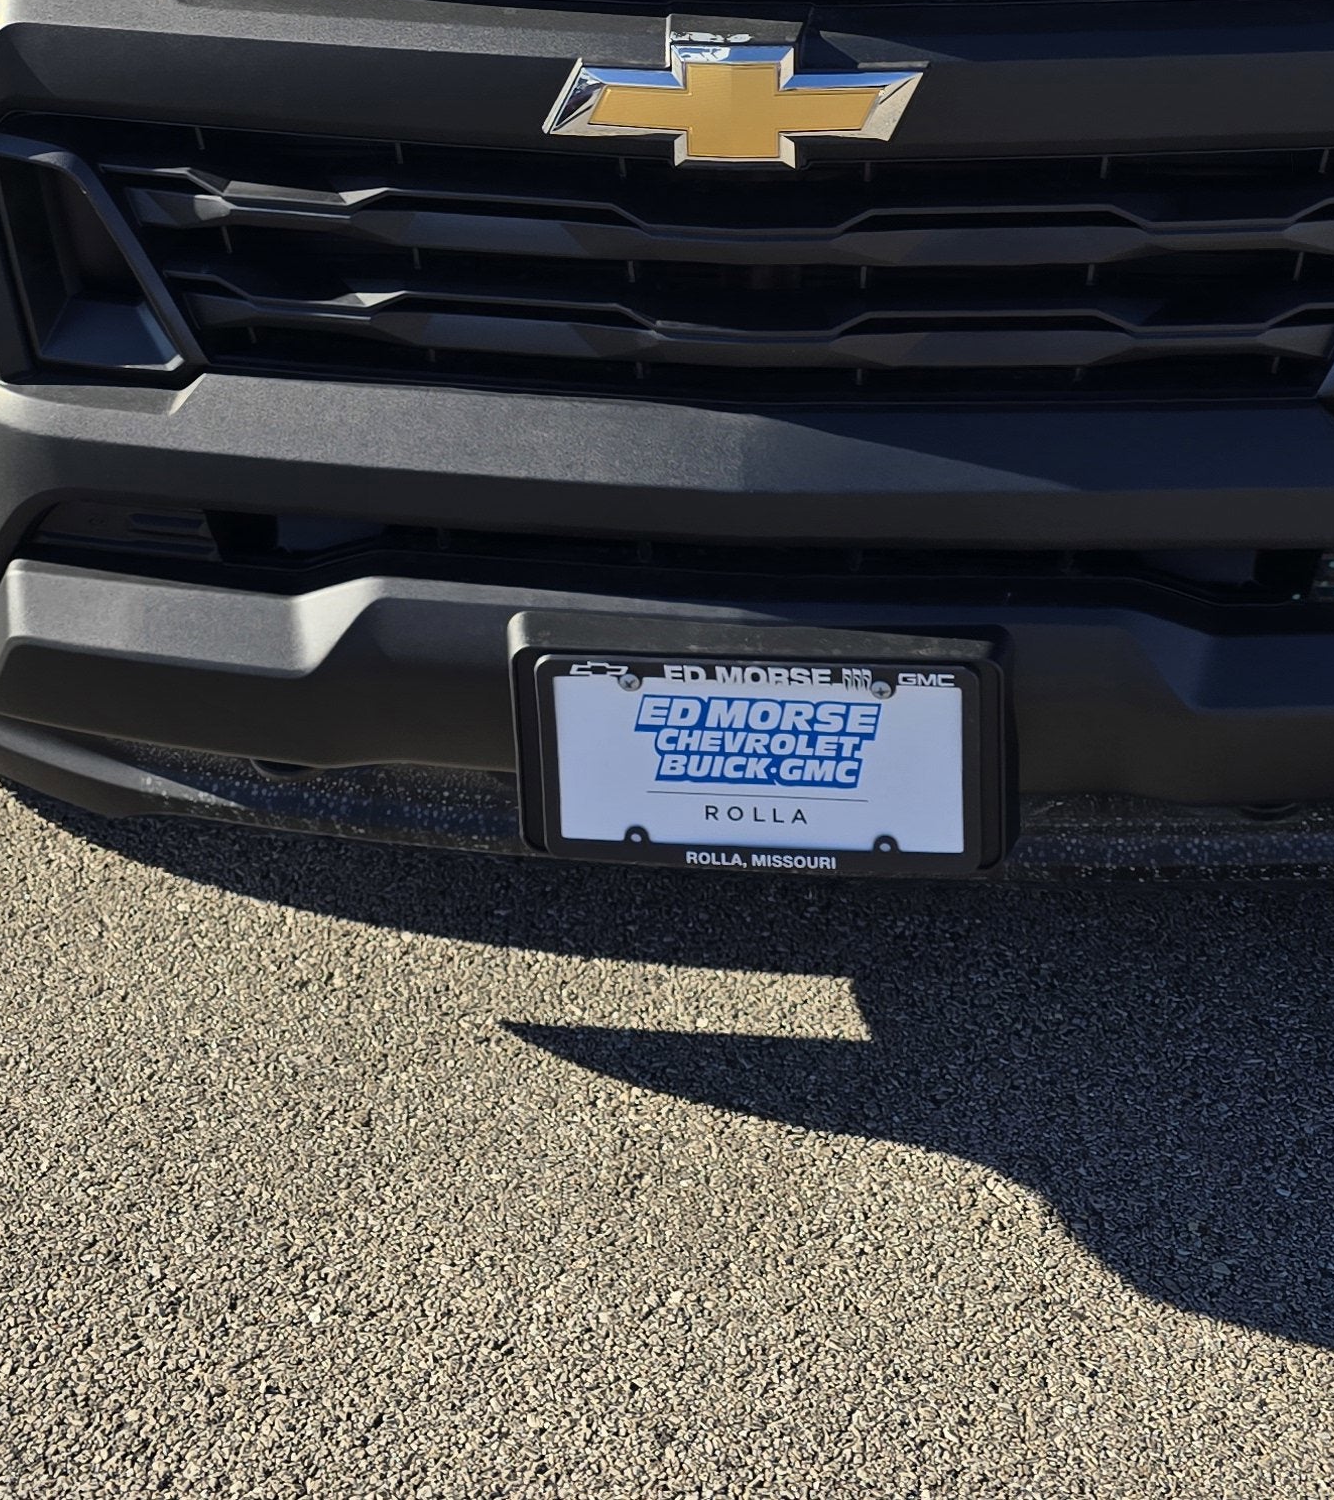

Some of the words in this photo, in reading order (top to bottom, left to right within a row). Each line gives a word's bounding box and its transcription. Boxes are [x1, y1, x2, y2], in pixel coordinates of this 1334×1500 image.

[663, 664, 707, 684] ED
[714, 666, 832, 687] MORSE
[898, 672, 955, 688] GMC
[637, 696, 702, 728] ED
[704, 699, 878, 734] MORSE
[656, 729, 860, 758] CHEVROLET
[705, 804, 808, 825] ROLLA
[685, 850, 748, 869] ROLLA,
[751, 853, 837, 870] MISSOURI
